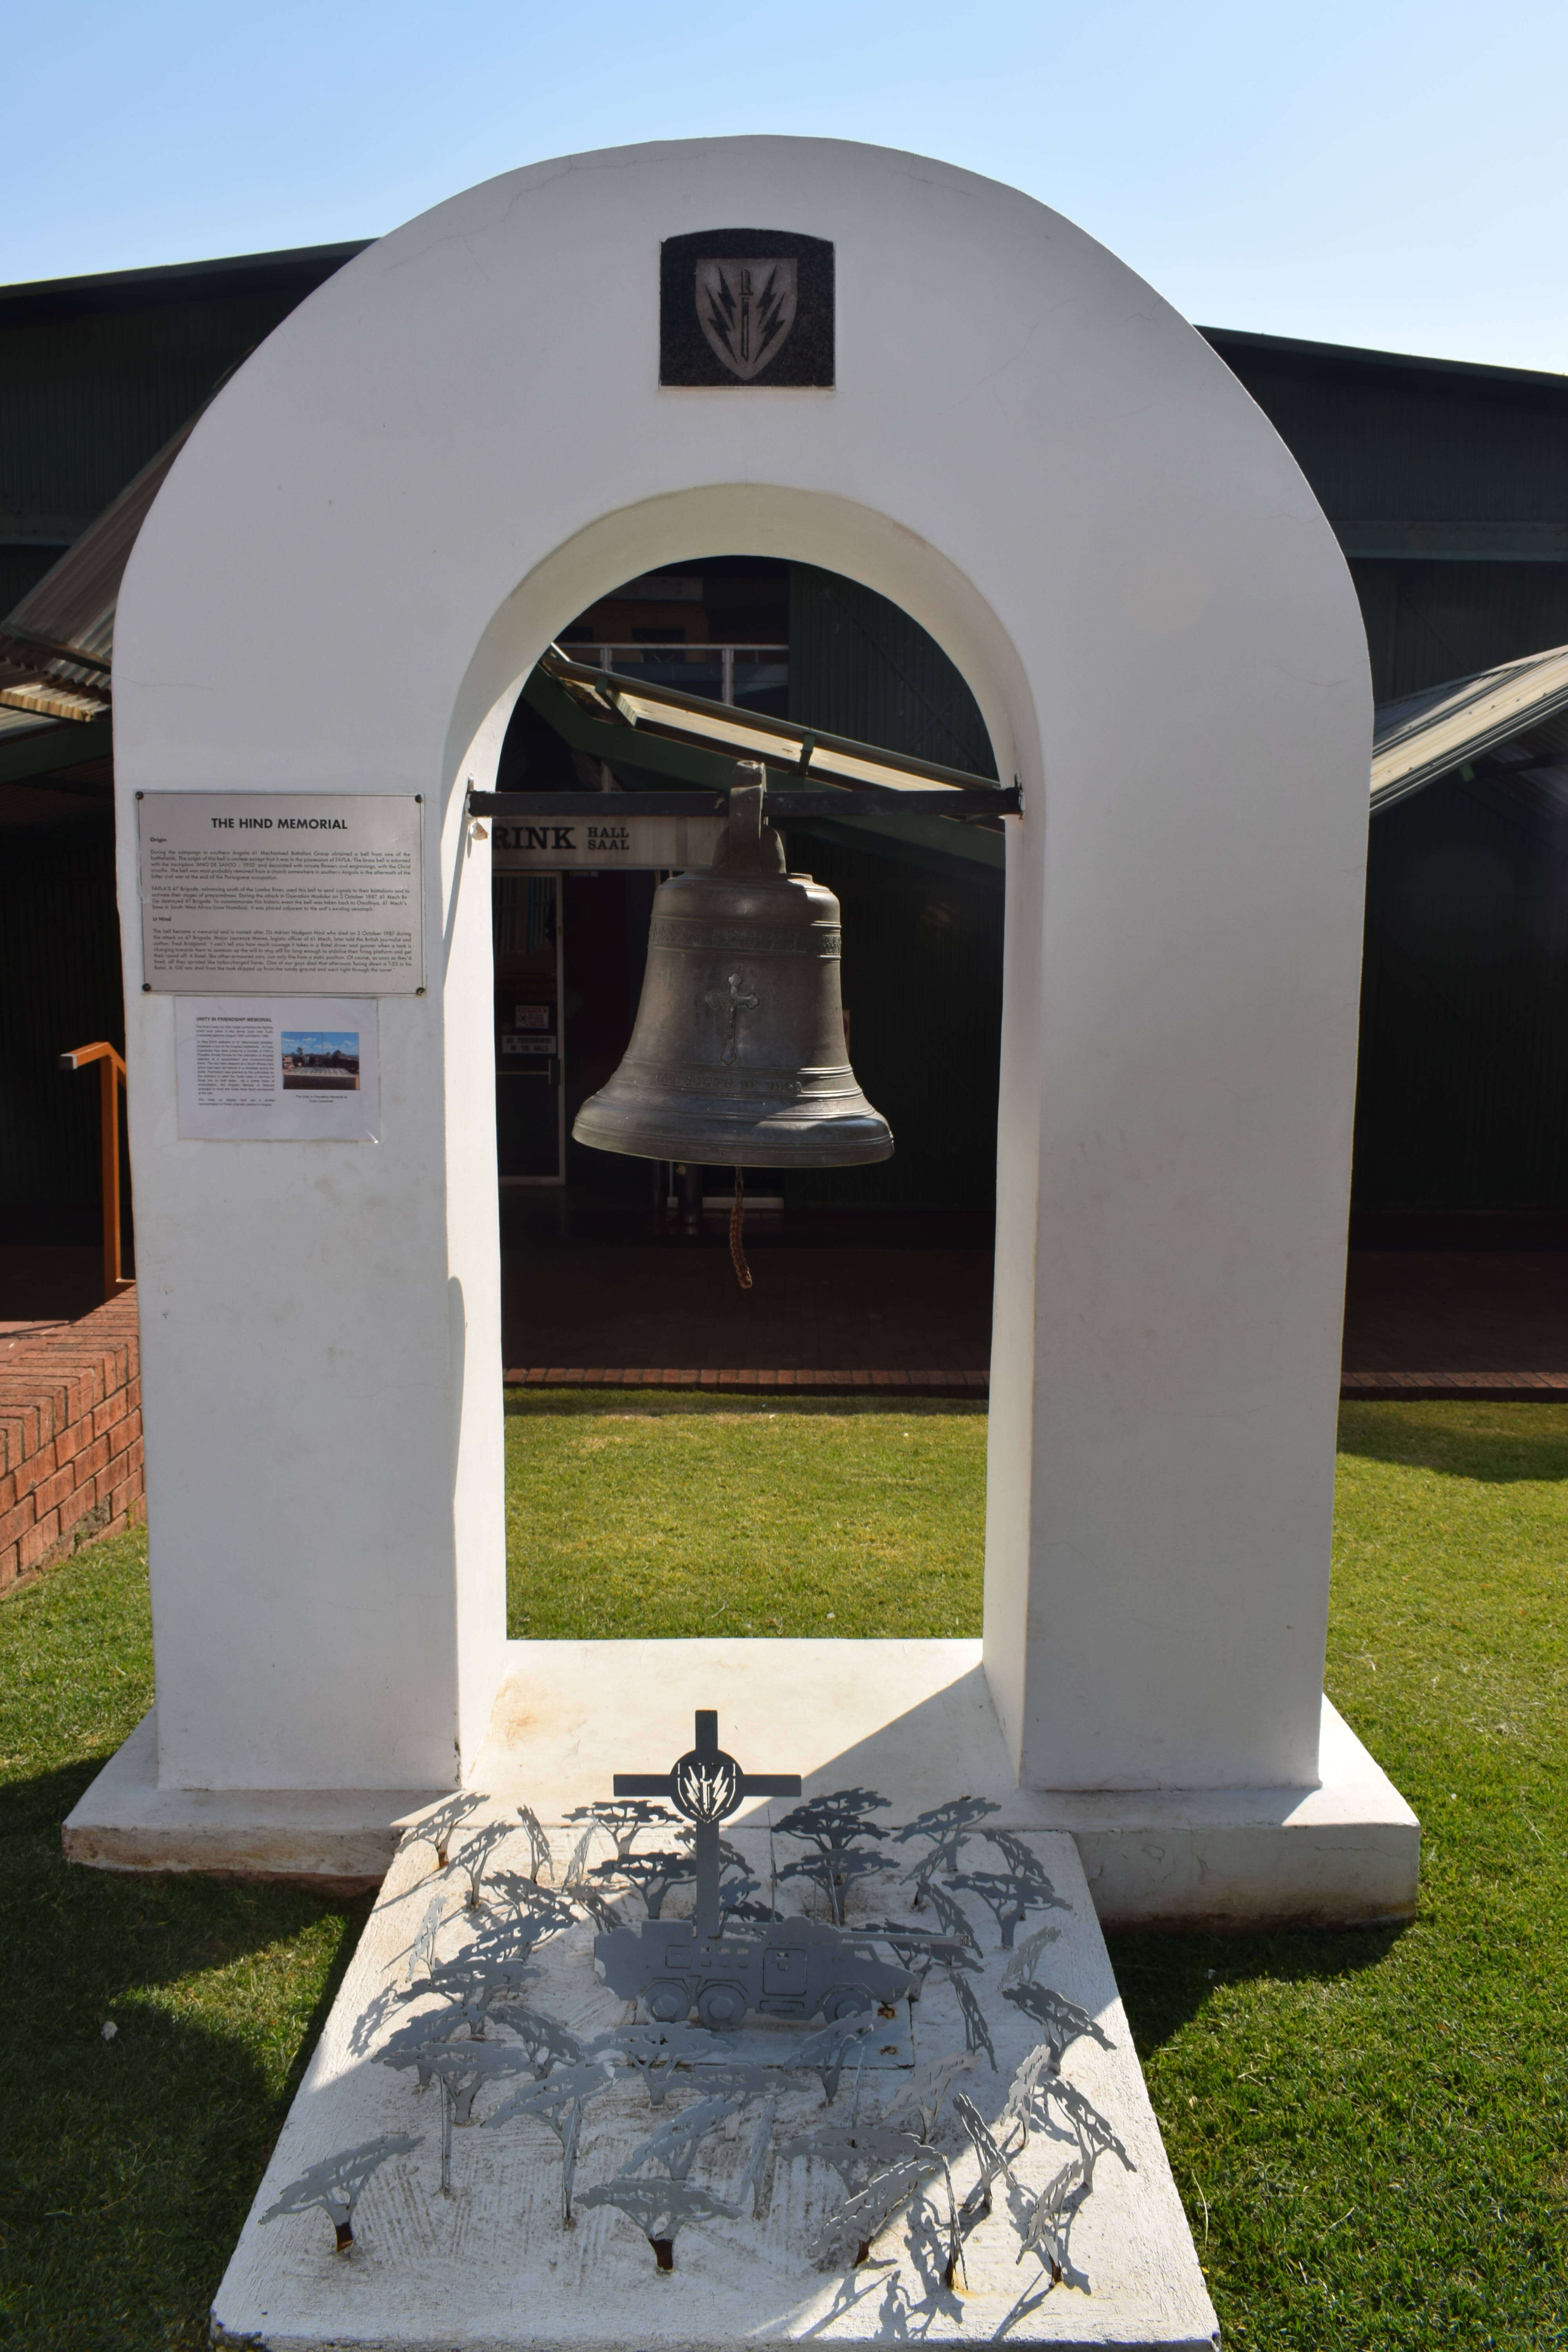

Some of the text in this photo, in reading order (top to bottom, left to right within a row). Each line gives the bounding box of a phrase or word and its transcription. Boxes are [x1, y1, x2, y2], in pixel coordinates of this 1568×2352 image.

[211, 818, 348, 829] THE HIND MEMORIAL
[587, 827, 629, 838] HALL
[588, 839, 630, 850] SAAL
[686, 1074, 733, 1089] SANTO
